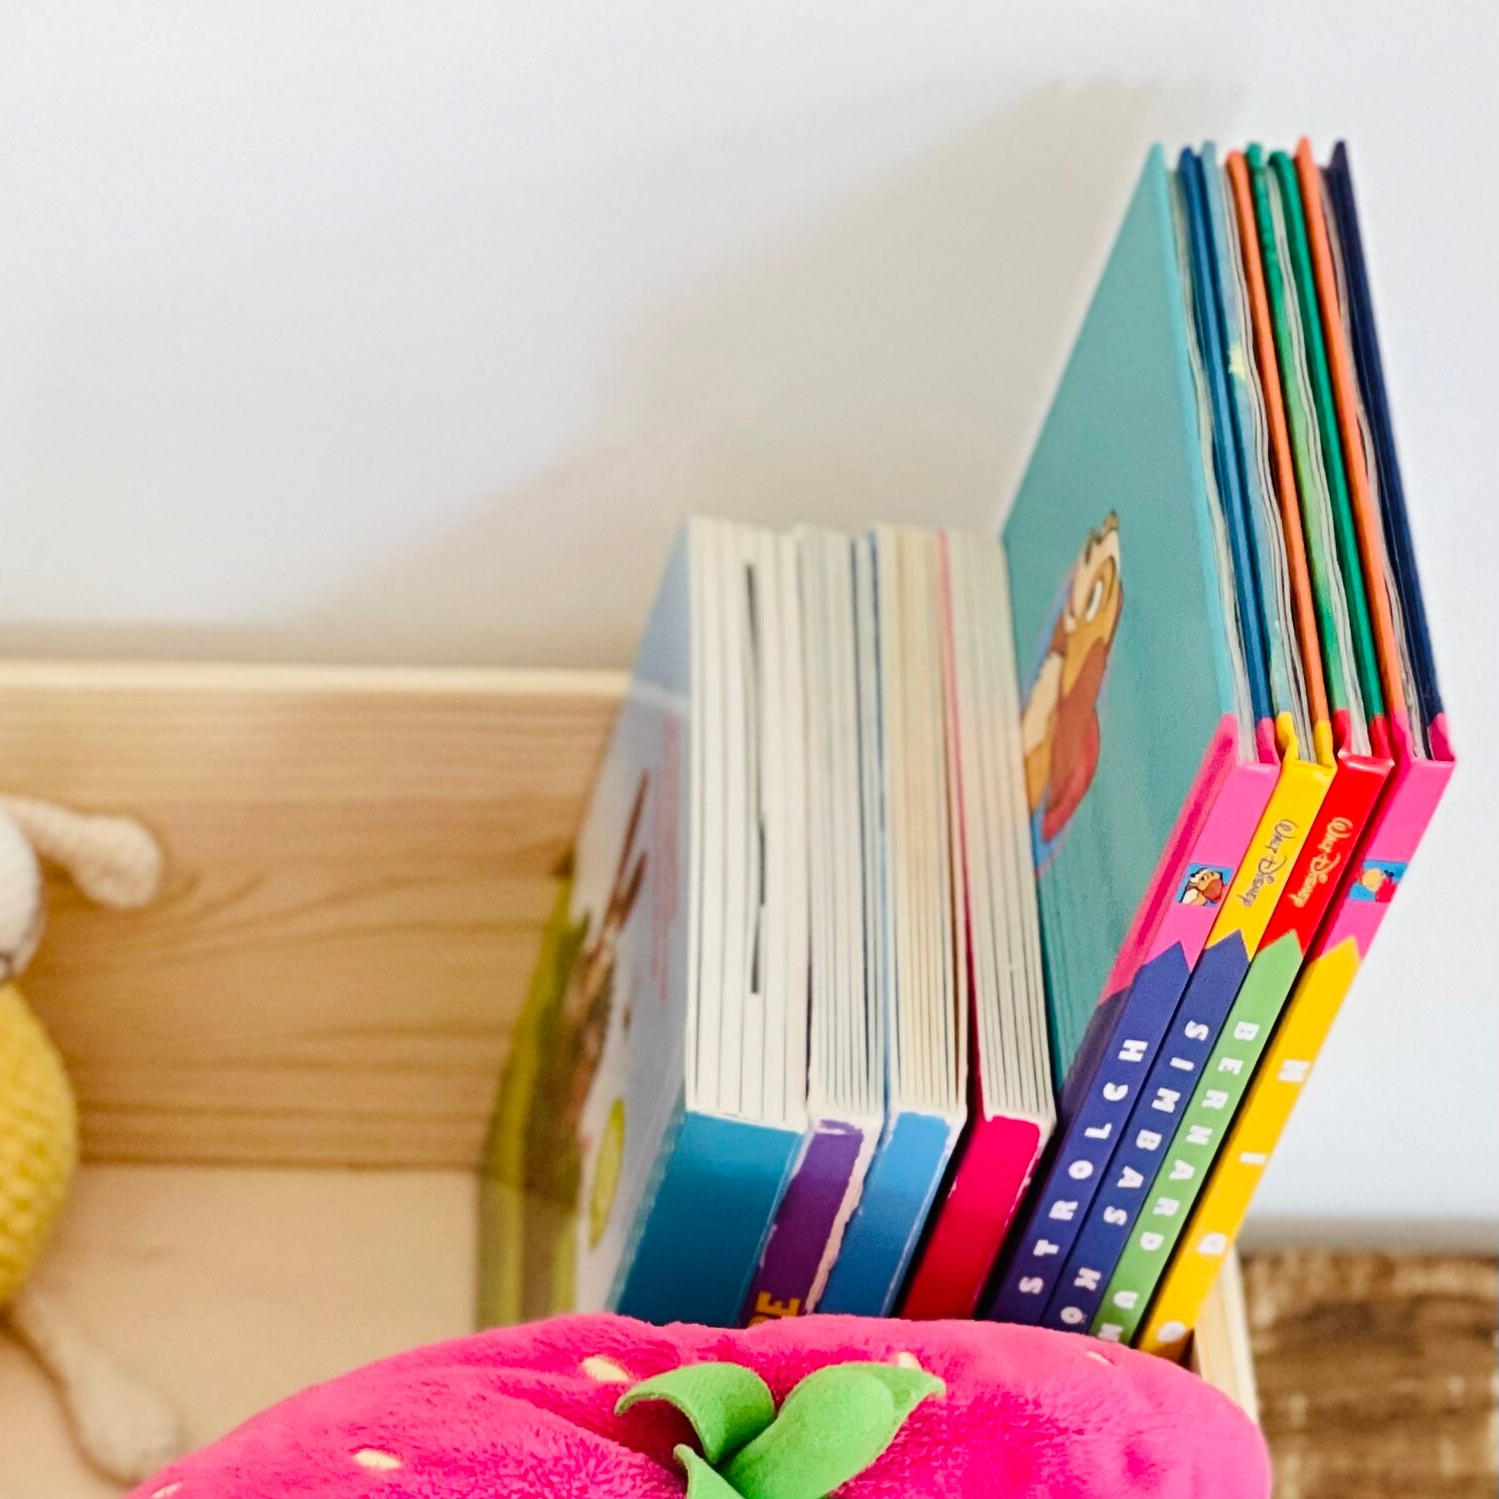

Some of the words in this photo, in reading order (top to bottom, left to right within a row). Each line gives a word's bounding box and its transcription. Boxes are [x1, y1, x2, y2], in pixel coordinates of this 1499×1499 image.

[1018, 1038, 1149, 1294] STROLCH
[1103, 1019, 1209, 1226] SIMBAS
[1140, 1020, 1260, 1251] BERNARD
[1097, 1290, 1139, 1342] UN
